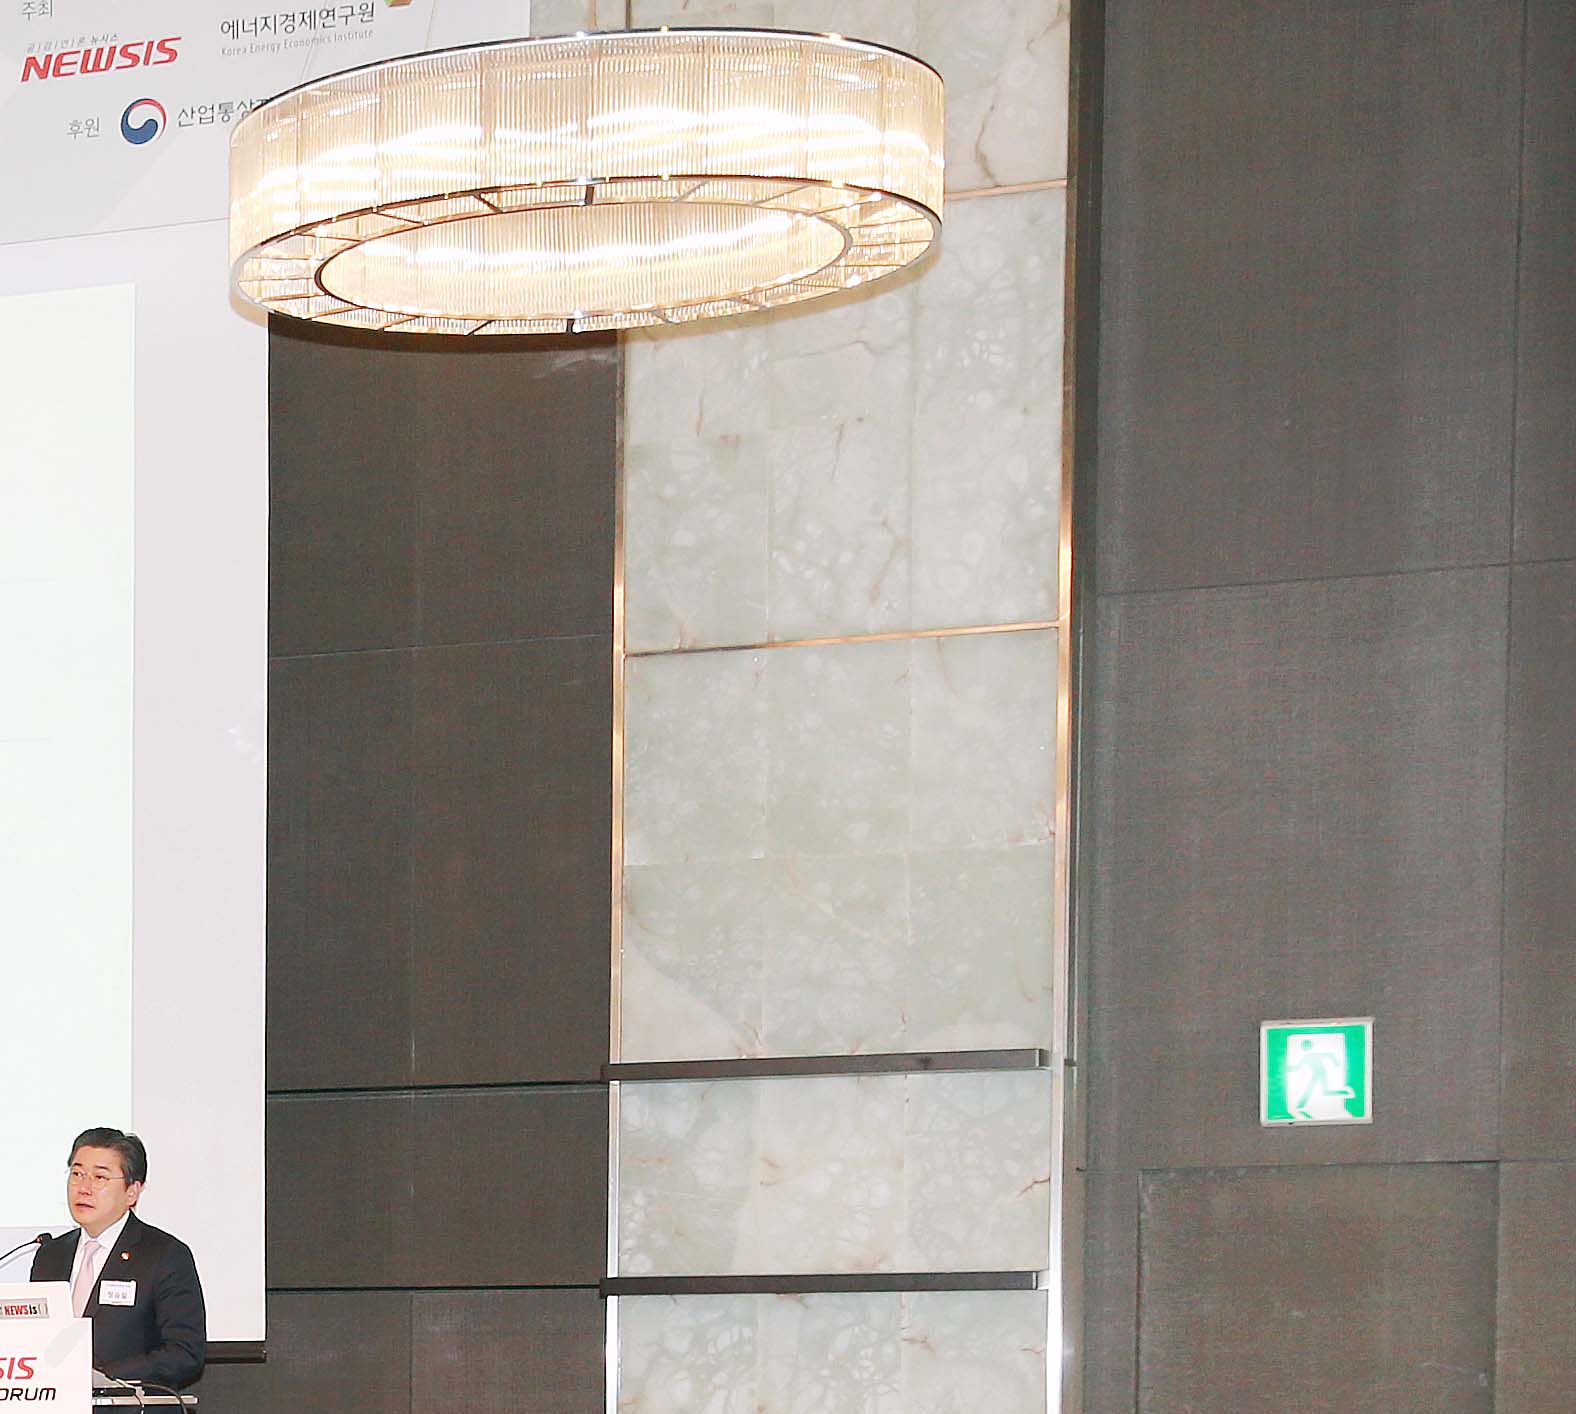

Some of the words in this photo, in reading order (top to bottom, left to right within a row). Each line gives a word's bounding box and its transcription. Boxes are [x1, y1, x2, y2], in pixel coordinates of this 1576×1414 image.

[220, 1, 375, 40] 에너지경제연구원
[21, 37, 182, 82] NEWSIS
[67, 117, 99, 139] 후원
[178, 98, 270, 127] 산업통상
